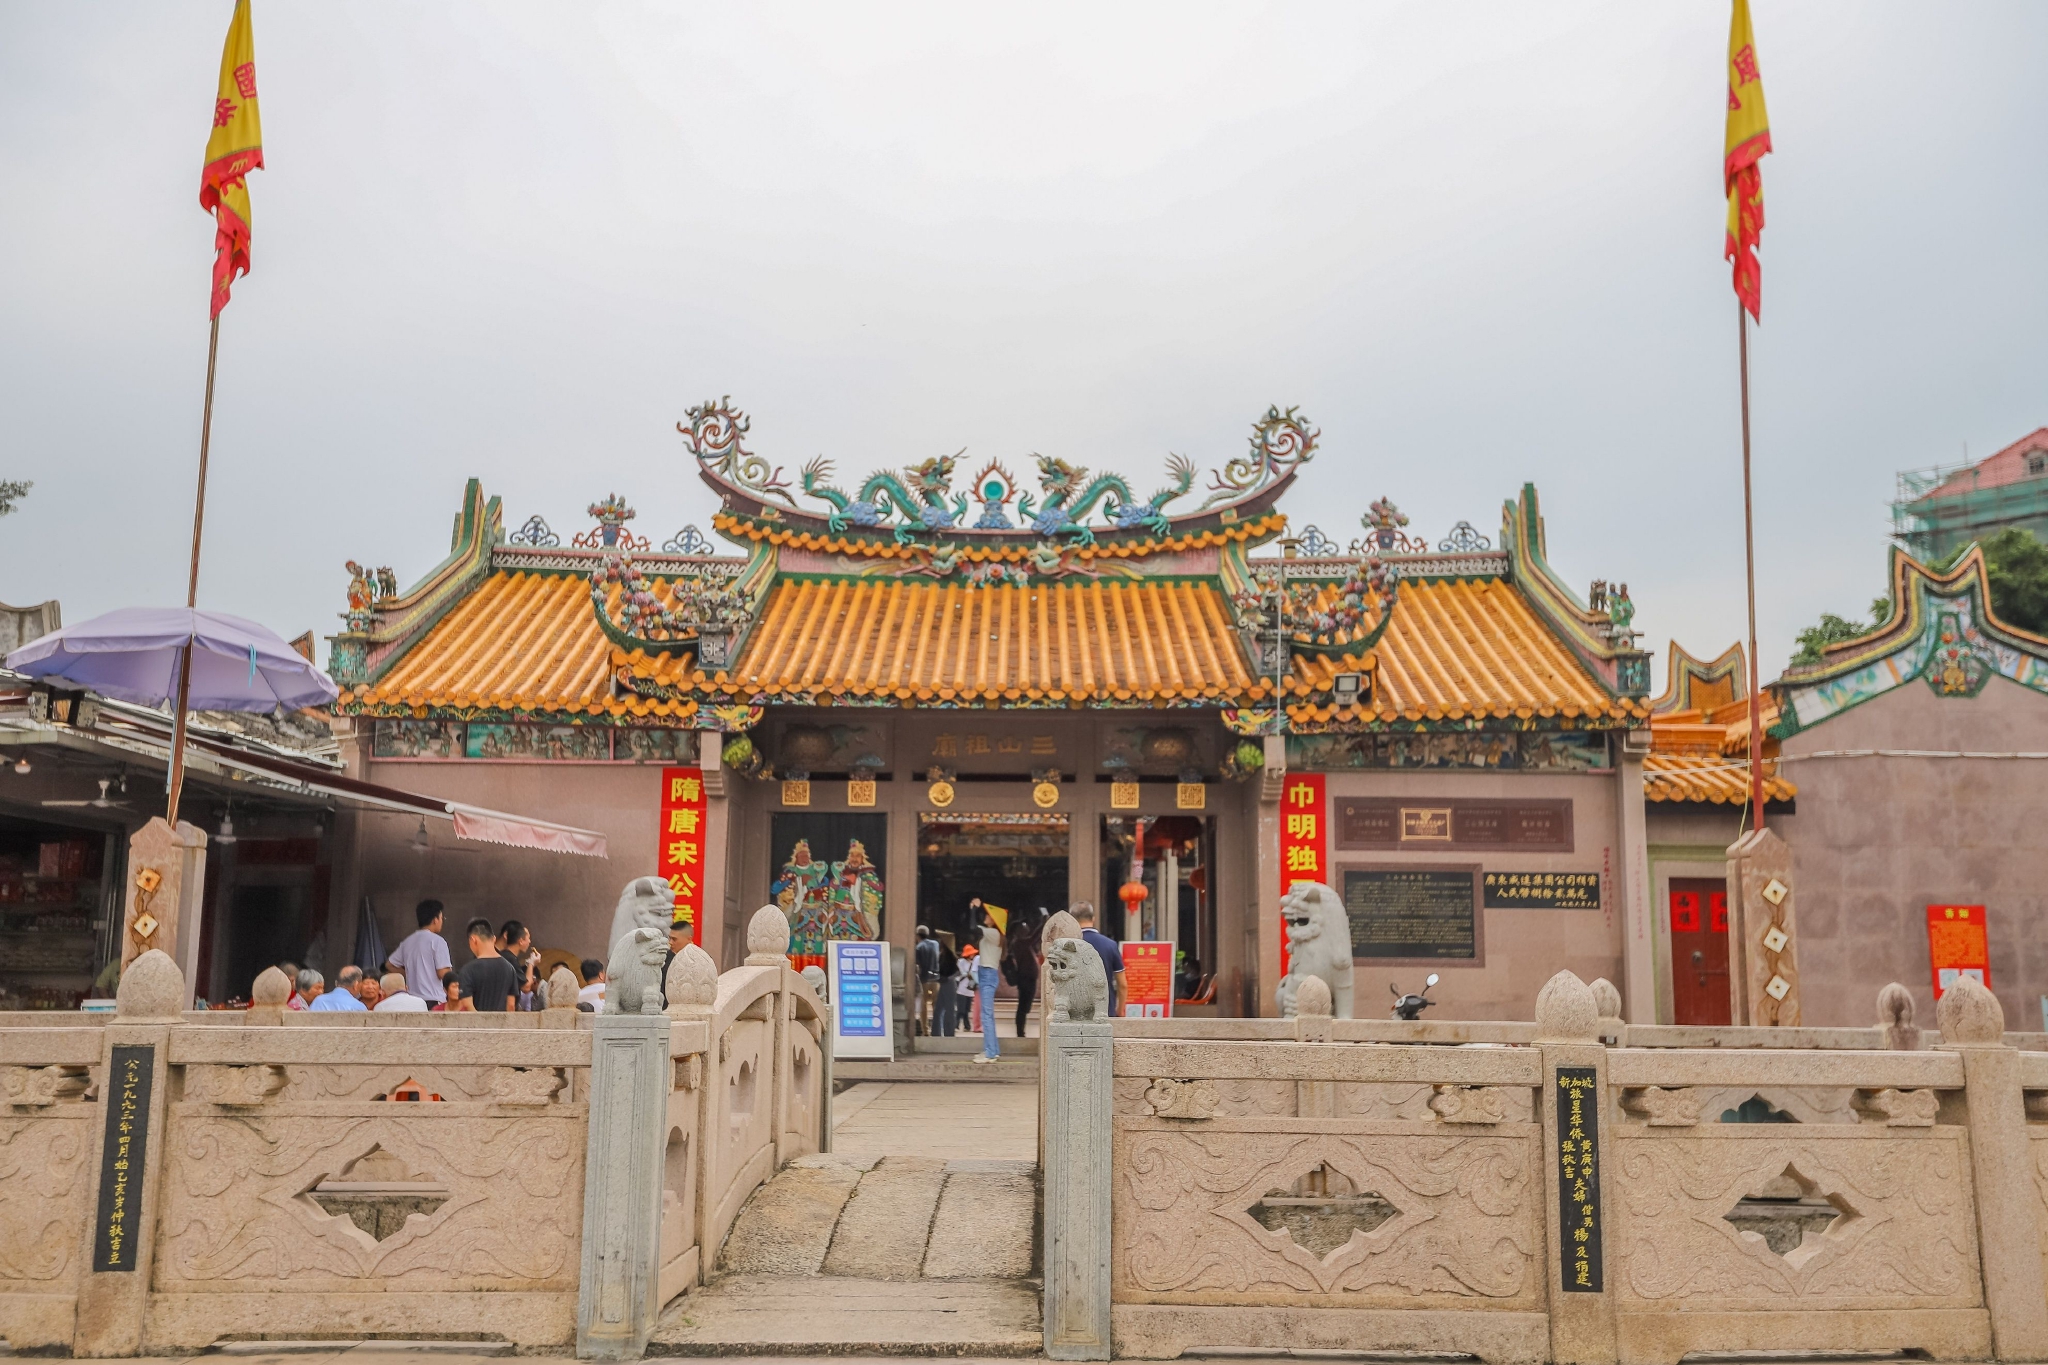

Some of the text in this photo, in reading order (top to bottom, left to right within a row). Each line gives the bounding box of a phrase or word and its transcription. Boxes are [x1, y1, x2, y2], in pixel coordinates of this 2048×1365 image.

[1287, 781, 1318, 884] 巾明独
[1559, 1076, 1594, 1089] 新加坡
